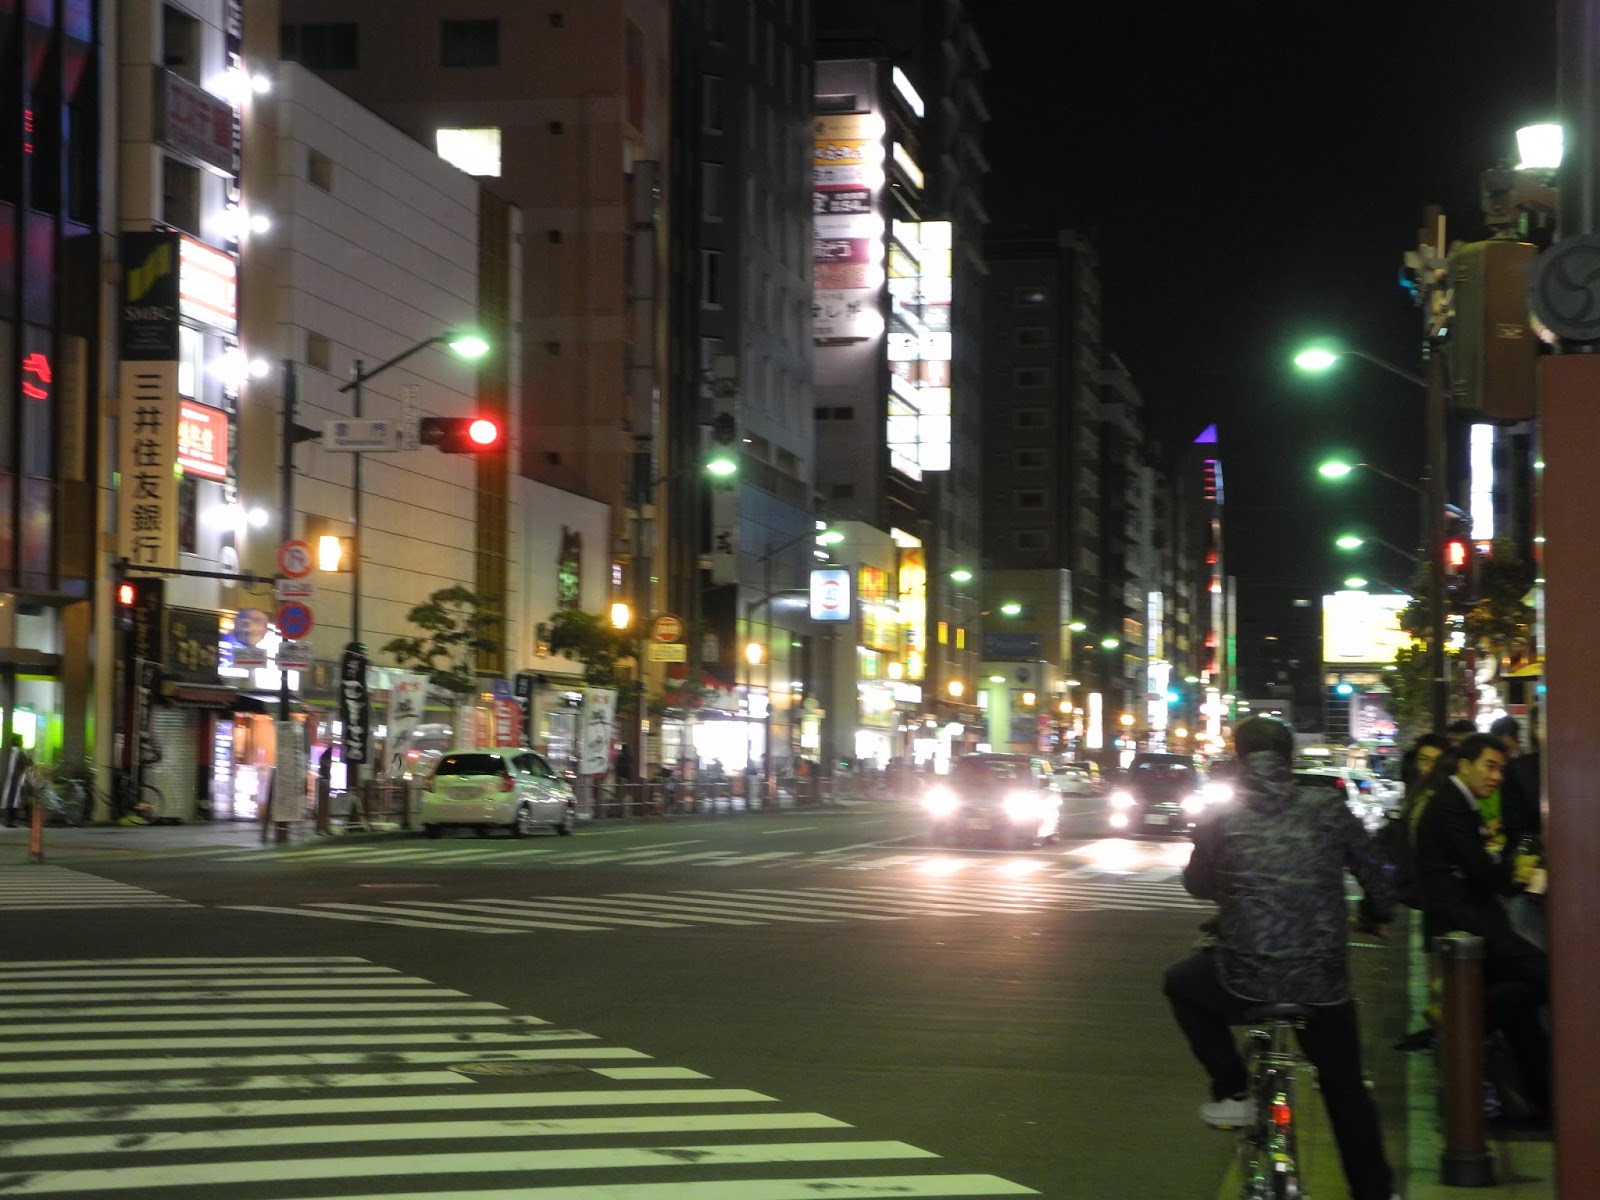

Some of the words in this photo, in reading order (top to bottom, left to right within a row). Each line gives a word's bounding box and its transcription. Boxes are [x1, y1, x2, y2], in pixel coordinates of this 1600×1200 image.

[124, 305, 174, 320] SMBC
[132, 373, 164, 564] 三井住友銀行
